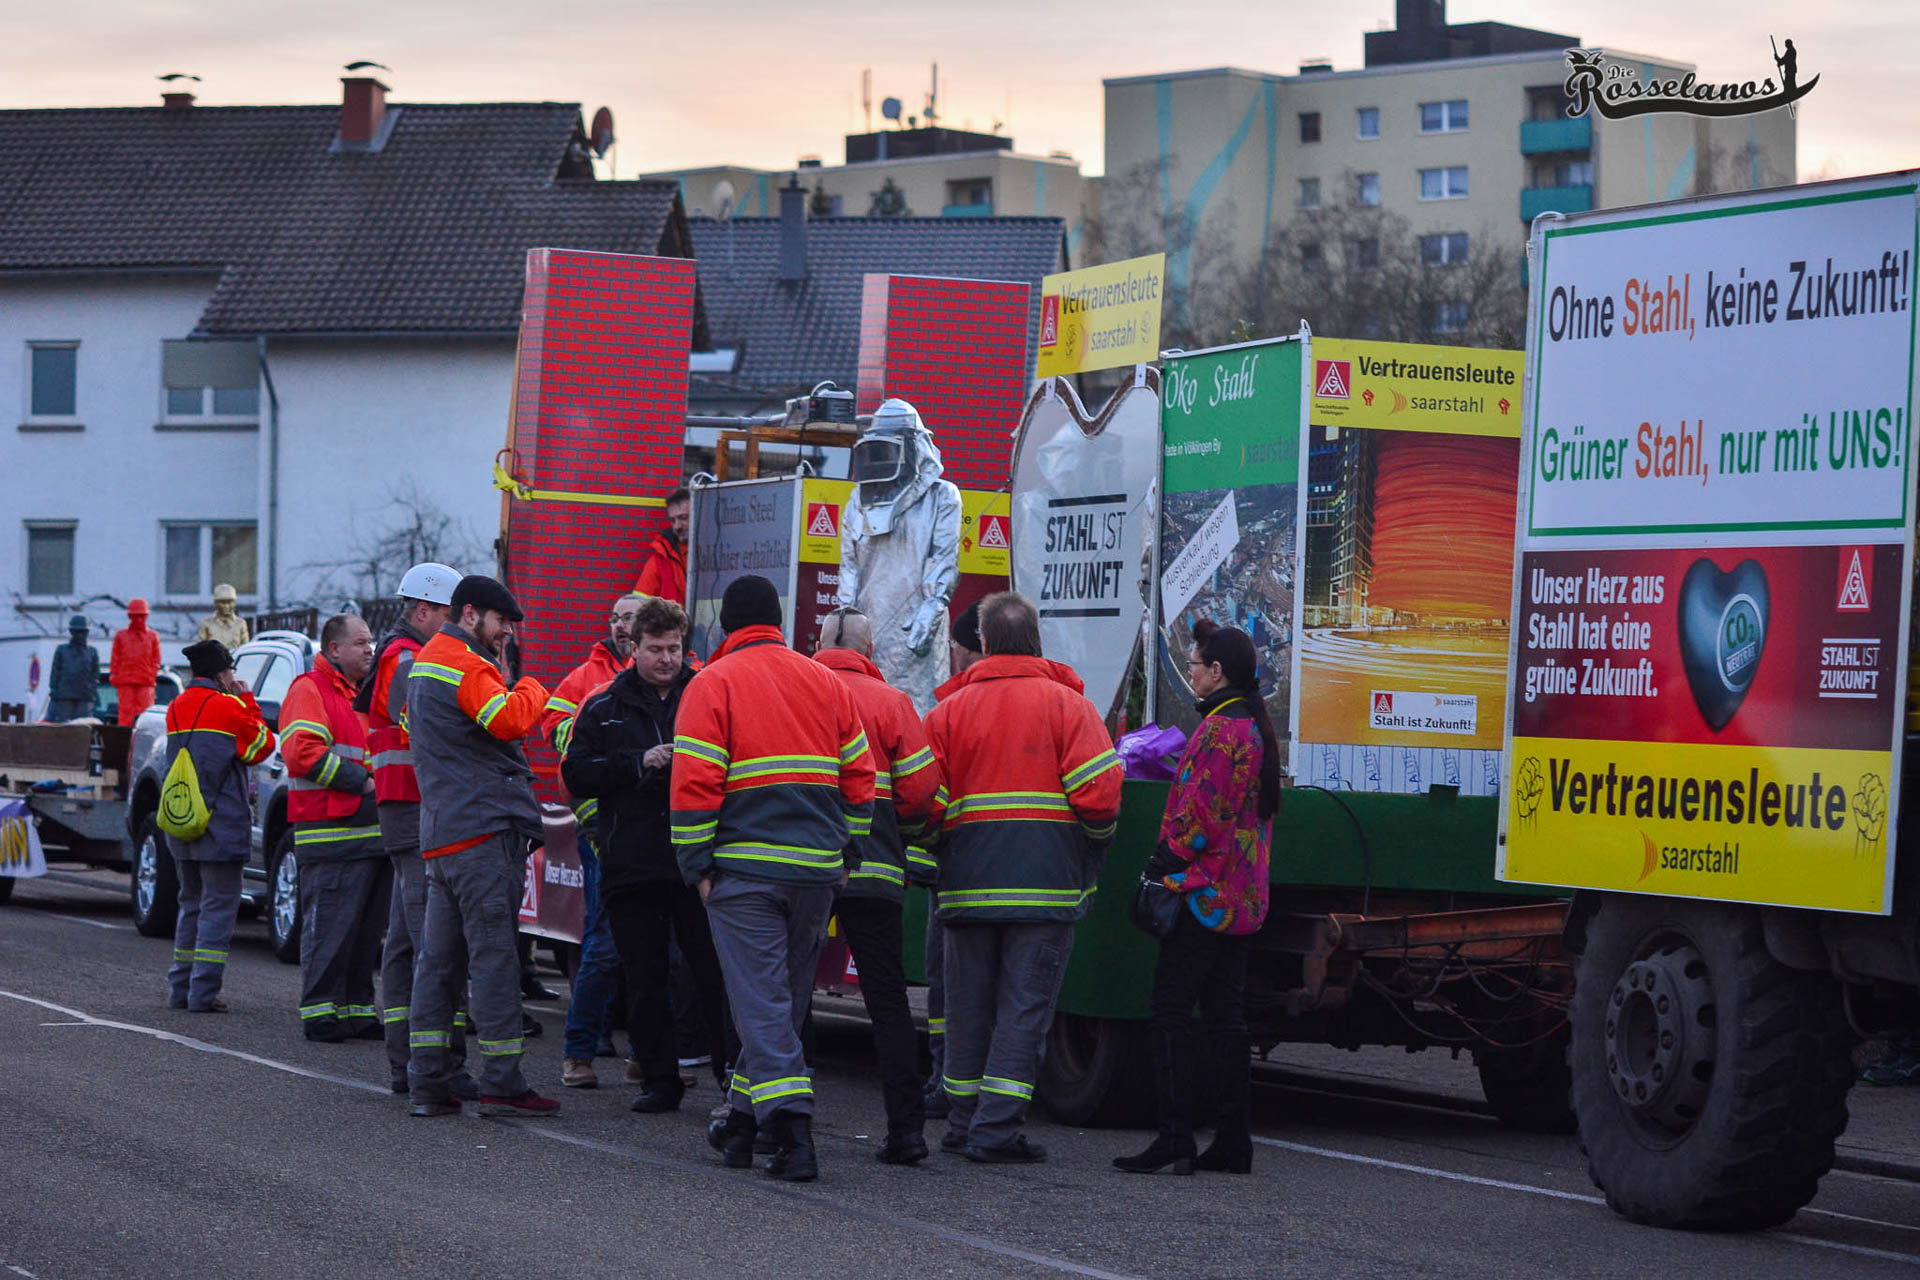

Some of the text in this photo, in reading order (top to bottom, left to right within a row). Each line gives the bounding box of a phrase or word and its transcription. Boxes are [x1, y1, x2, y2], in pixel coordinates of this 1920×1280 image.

[1062, 270, 1159, 315] Vertrauensleute
[1548, 250, 1909, 342] Ohne Stahl, keine Zukunft!
[1091, 319, 1137, 351] saarstahl
[1165, 353, 1260, 415] Öko Stahl
[1358, 355, 1516, 386] Vertrauensleute
[1411, 396, 1484, 414] saarstahl
[1540, 406, 1903, 487] Grüner Stahl, nur mit UNS!
[1045, 512, 1127, 553] STAHL IST
[818, 571, 841, 585] Unse
[1041, 561, 1123, 600] ZUKUNFT
[1531, 567, 1664, 605] Unser Herz aus
[1527, 612, 1651, 651] Stahl hat eine
[1821, 647, 1880, 667] STAHL IST
[1525, 657, 1658, 702] grüne Zukunft.
[1819, 669, 1879, 690] ZUKUNFT
[1443, 698, 1475, 707] saarstahl
[1375, 715, 1471, 730] Stahl ist Zukunft!
[1549, 758, 1847, 831] Vertrauensleute
[1661, 842, 1739, 874] saarstahl
